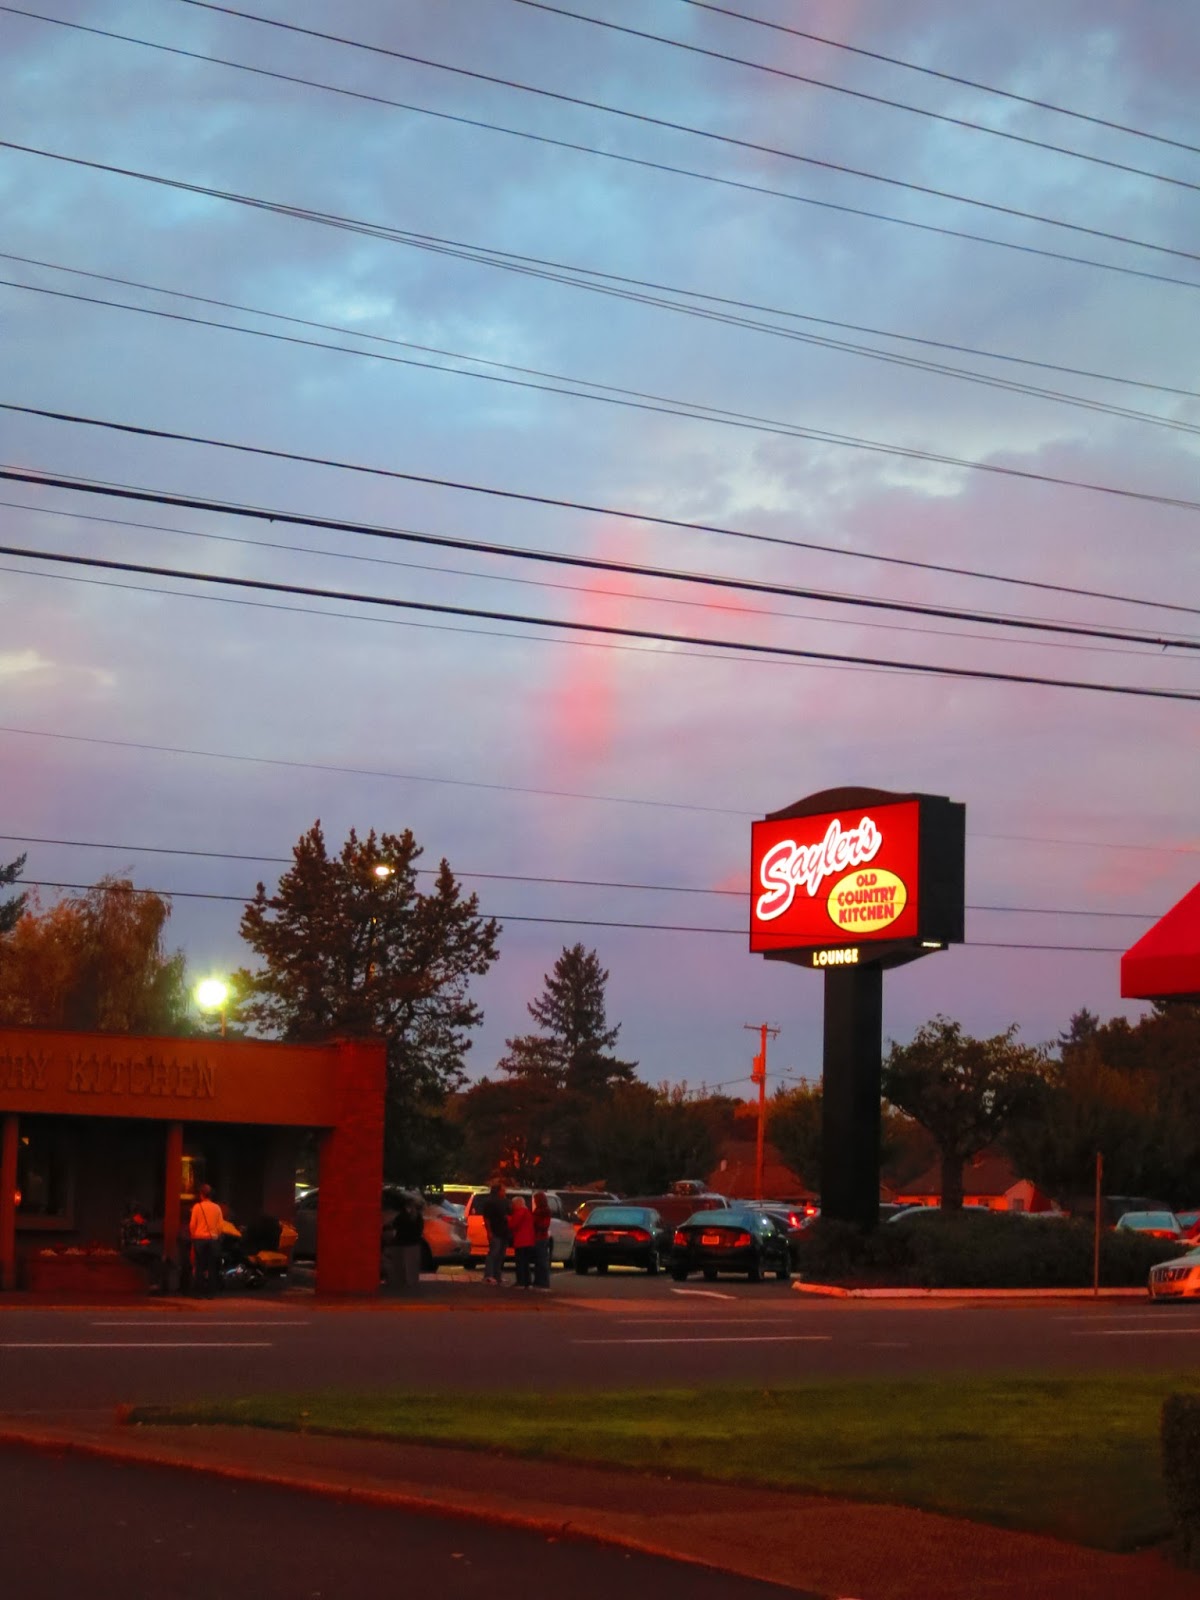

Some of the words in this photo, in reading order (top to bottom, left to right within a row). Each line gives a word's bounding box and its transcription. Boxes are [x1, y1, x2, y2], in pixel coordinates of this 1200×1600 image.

[757, 816, 882, 920] Sayler's
[855, 873, 878, 887] OLD
[838, 886, 896, 905] COUNTRY
[838, 904, 895, 923] KITCHEN
[813, 949, 859, 966] LOUNGE
[68, 1053, 217, 1098] KITCHEN
